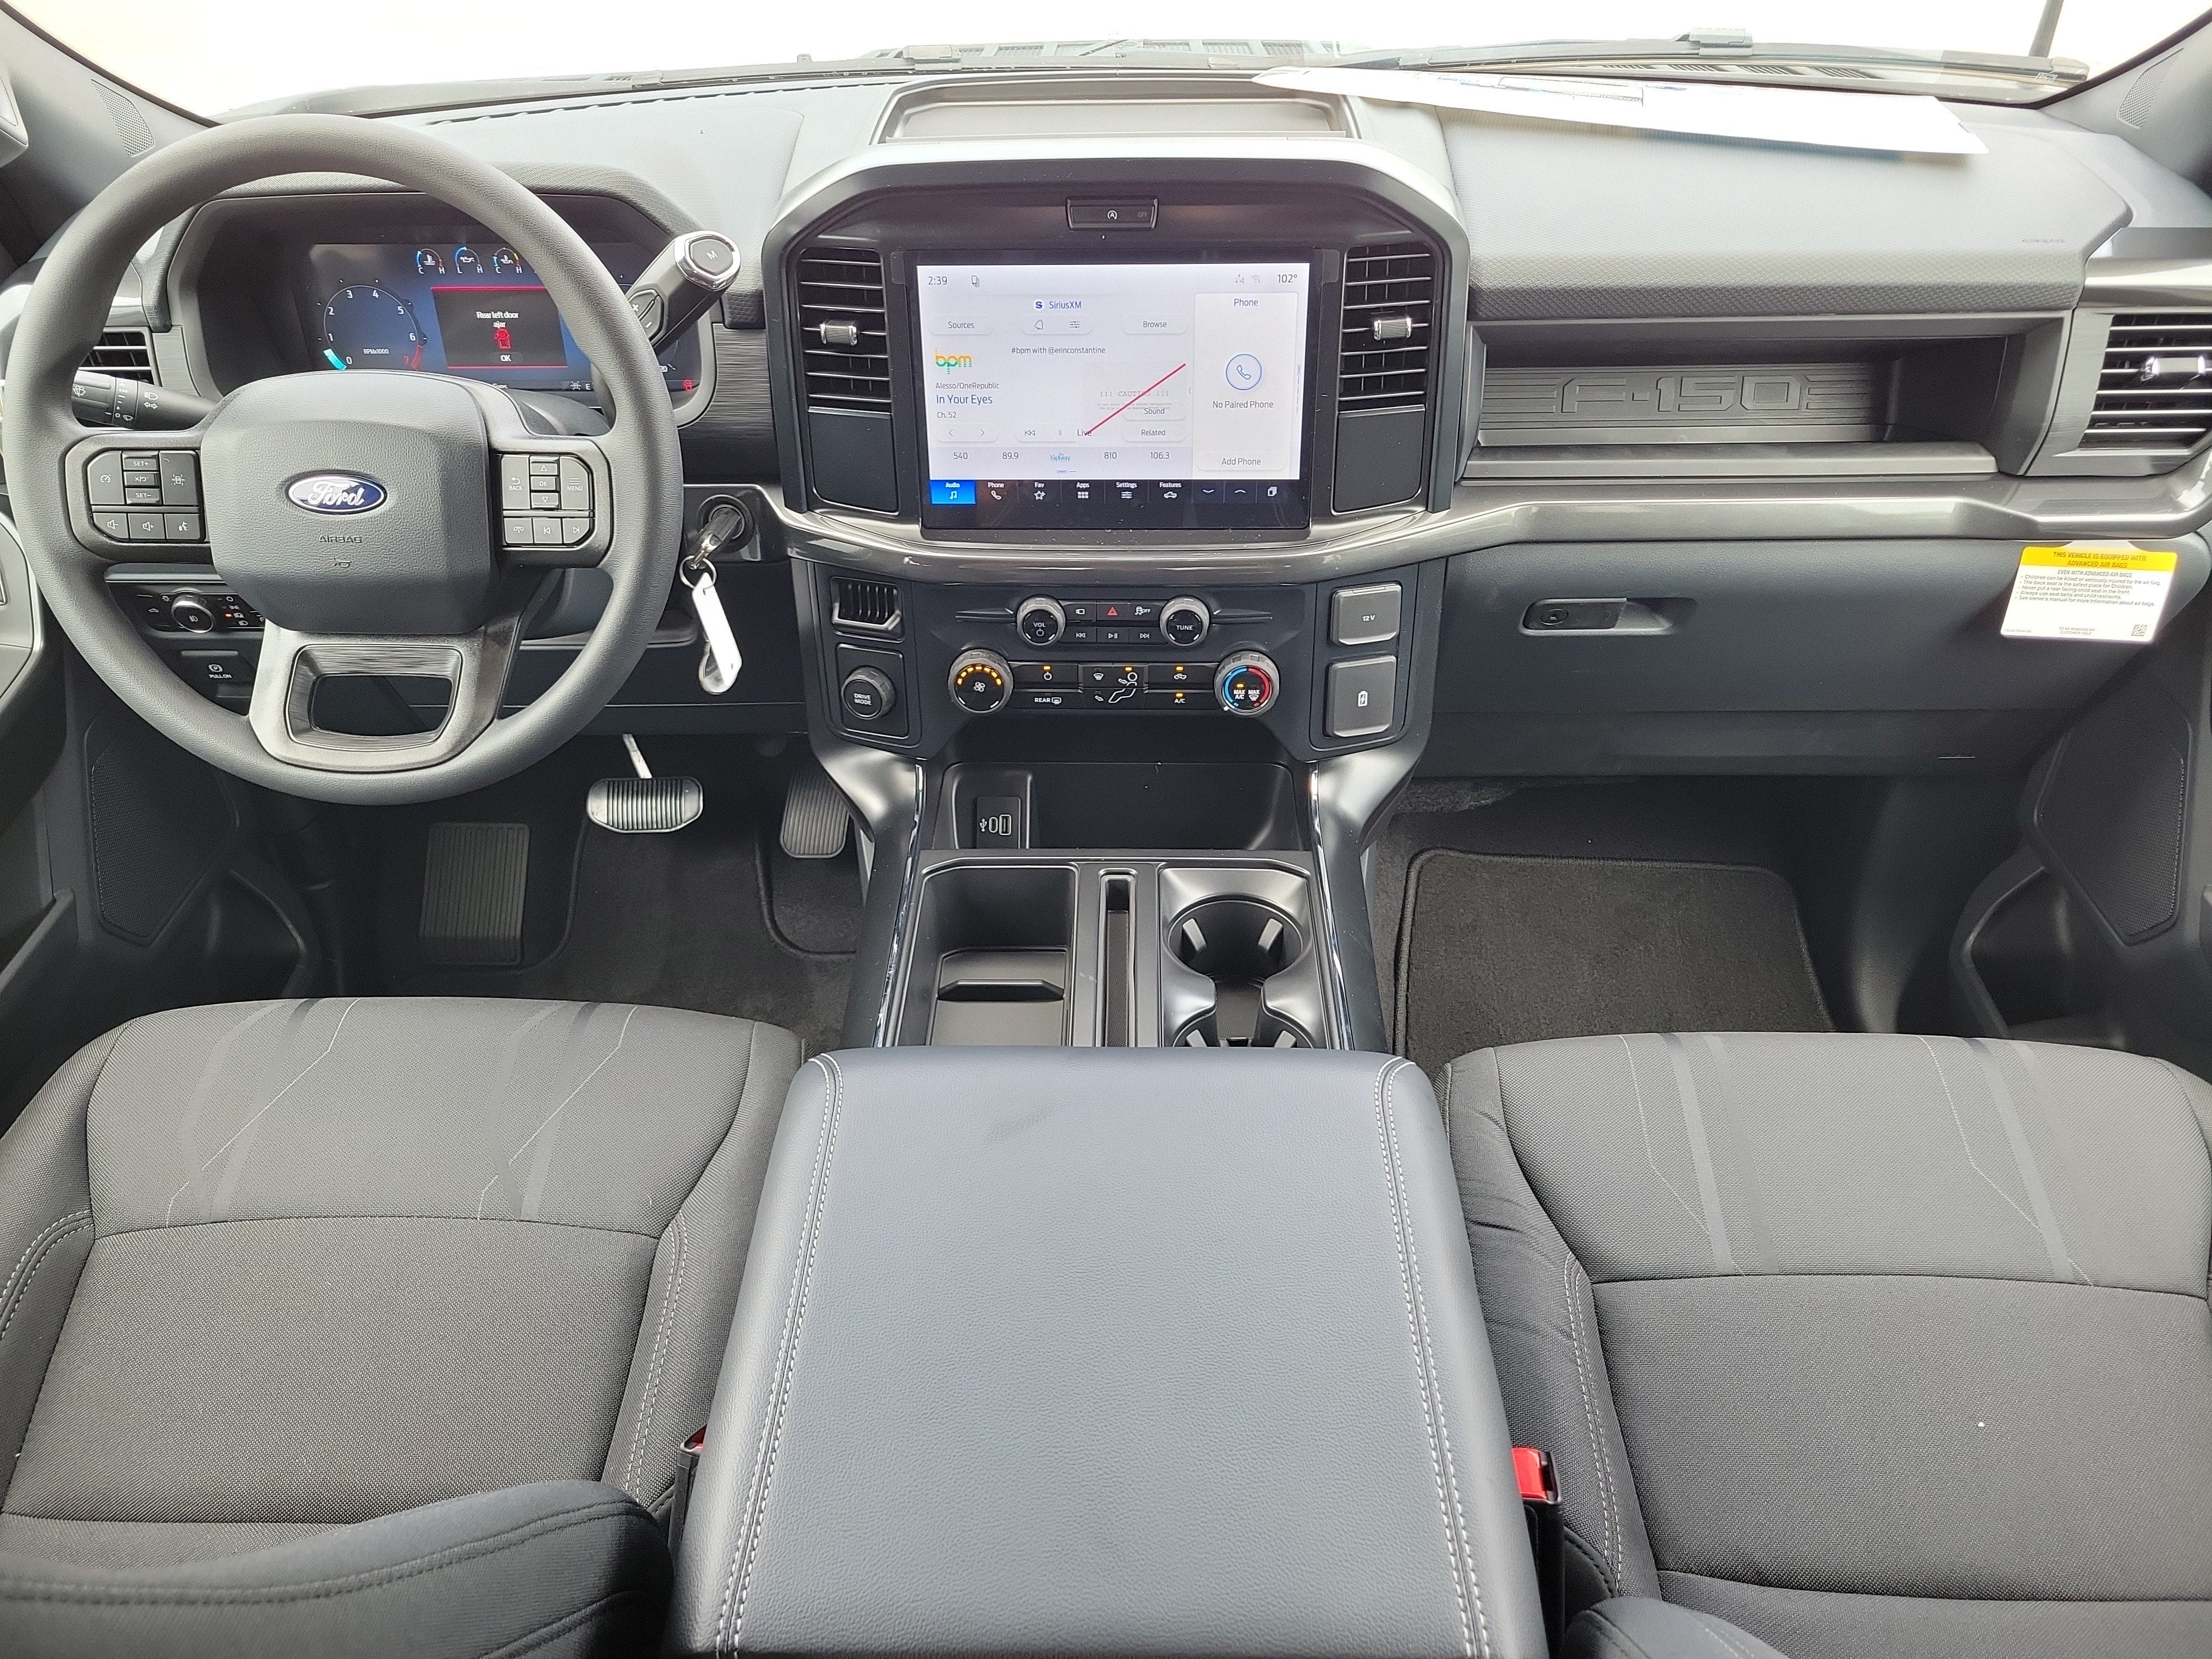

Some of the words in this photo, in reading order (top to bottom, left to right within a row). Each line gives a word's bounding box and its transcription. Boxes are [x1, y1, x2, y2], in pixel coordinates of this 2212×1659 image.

[706, 250, 719, 261] M
[928, 276, 947, 285] 2:39
[1278, 274, 1298, 283] 102°
[347, 290, 353, 299] 3
[373, 290, 379, 298] 4
[1049, 301, 1082, 309] SiriusXM
[1234, 298, 1259, 307] Phone
[328, 307, 335, 315] 2
[398, 306, 404, 315] 5
[329, 333, 334, 341] 1
[409, 332, 416, 341] 6
[346, 356, 352, 365] 0
[403, 356, 409, 365] 7
[934, 347, 973, 375] bpm
[1561, 375, 1803, 413] F-150
[936, 394, 945, 404] In
[947, 394, 969, 404] Your
[971, 394, 993, 405] Eyes
[1077, 428, 1092, 437] Live
[307, 480, 365, 506] Ford
[318, 535, 363, 543] AIRBAG
